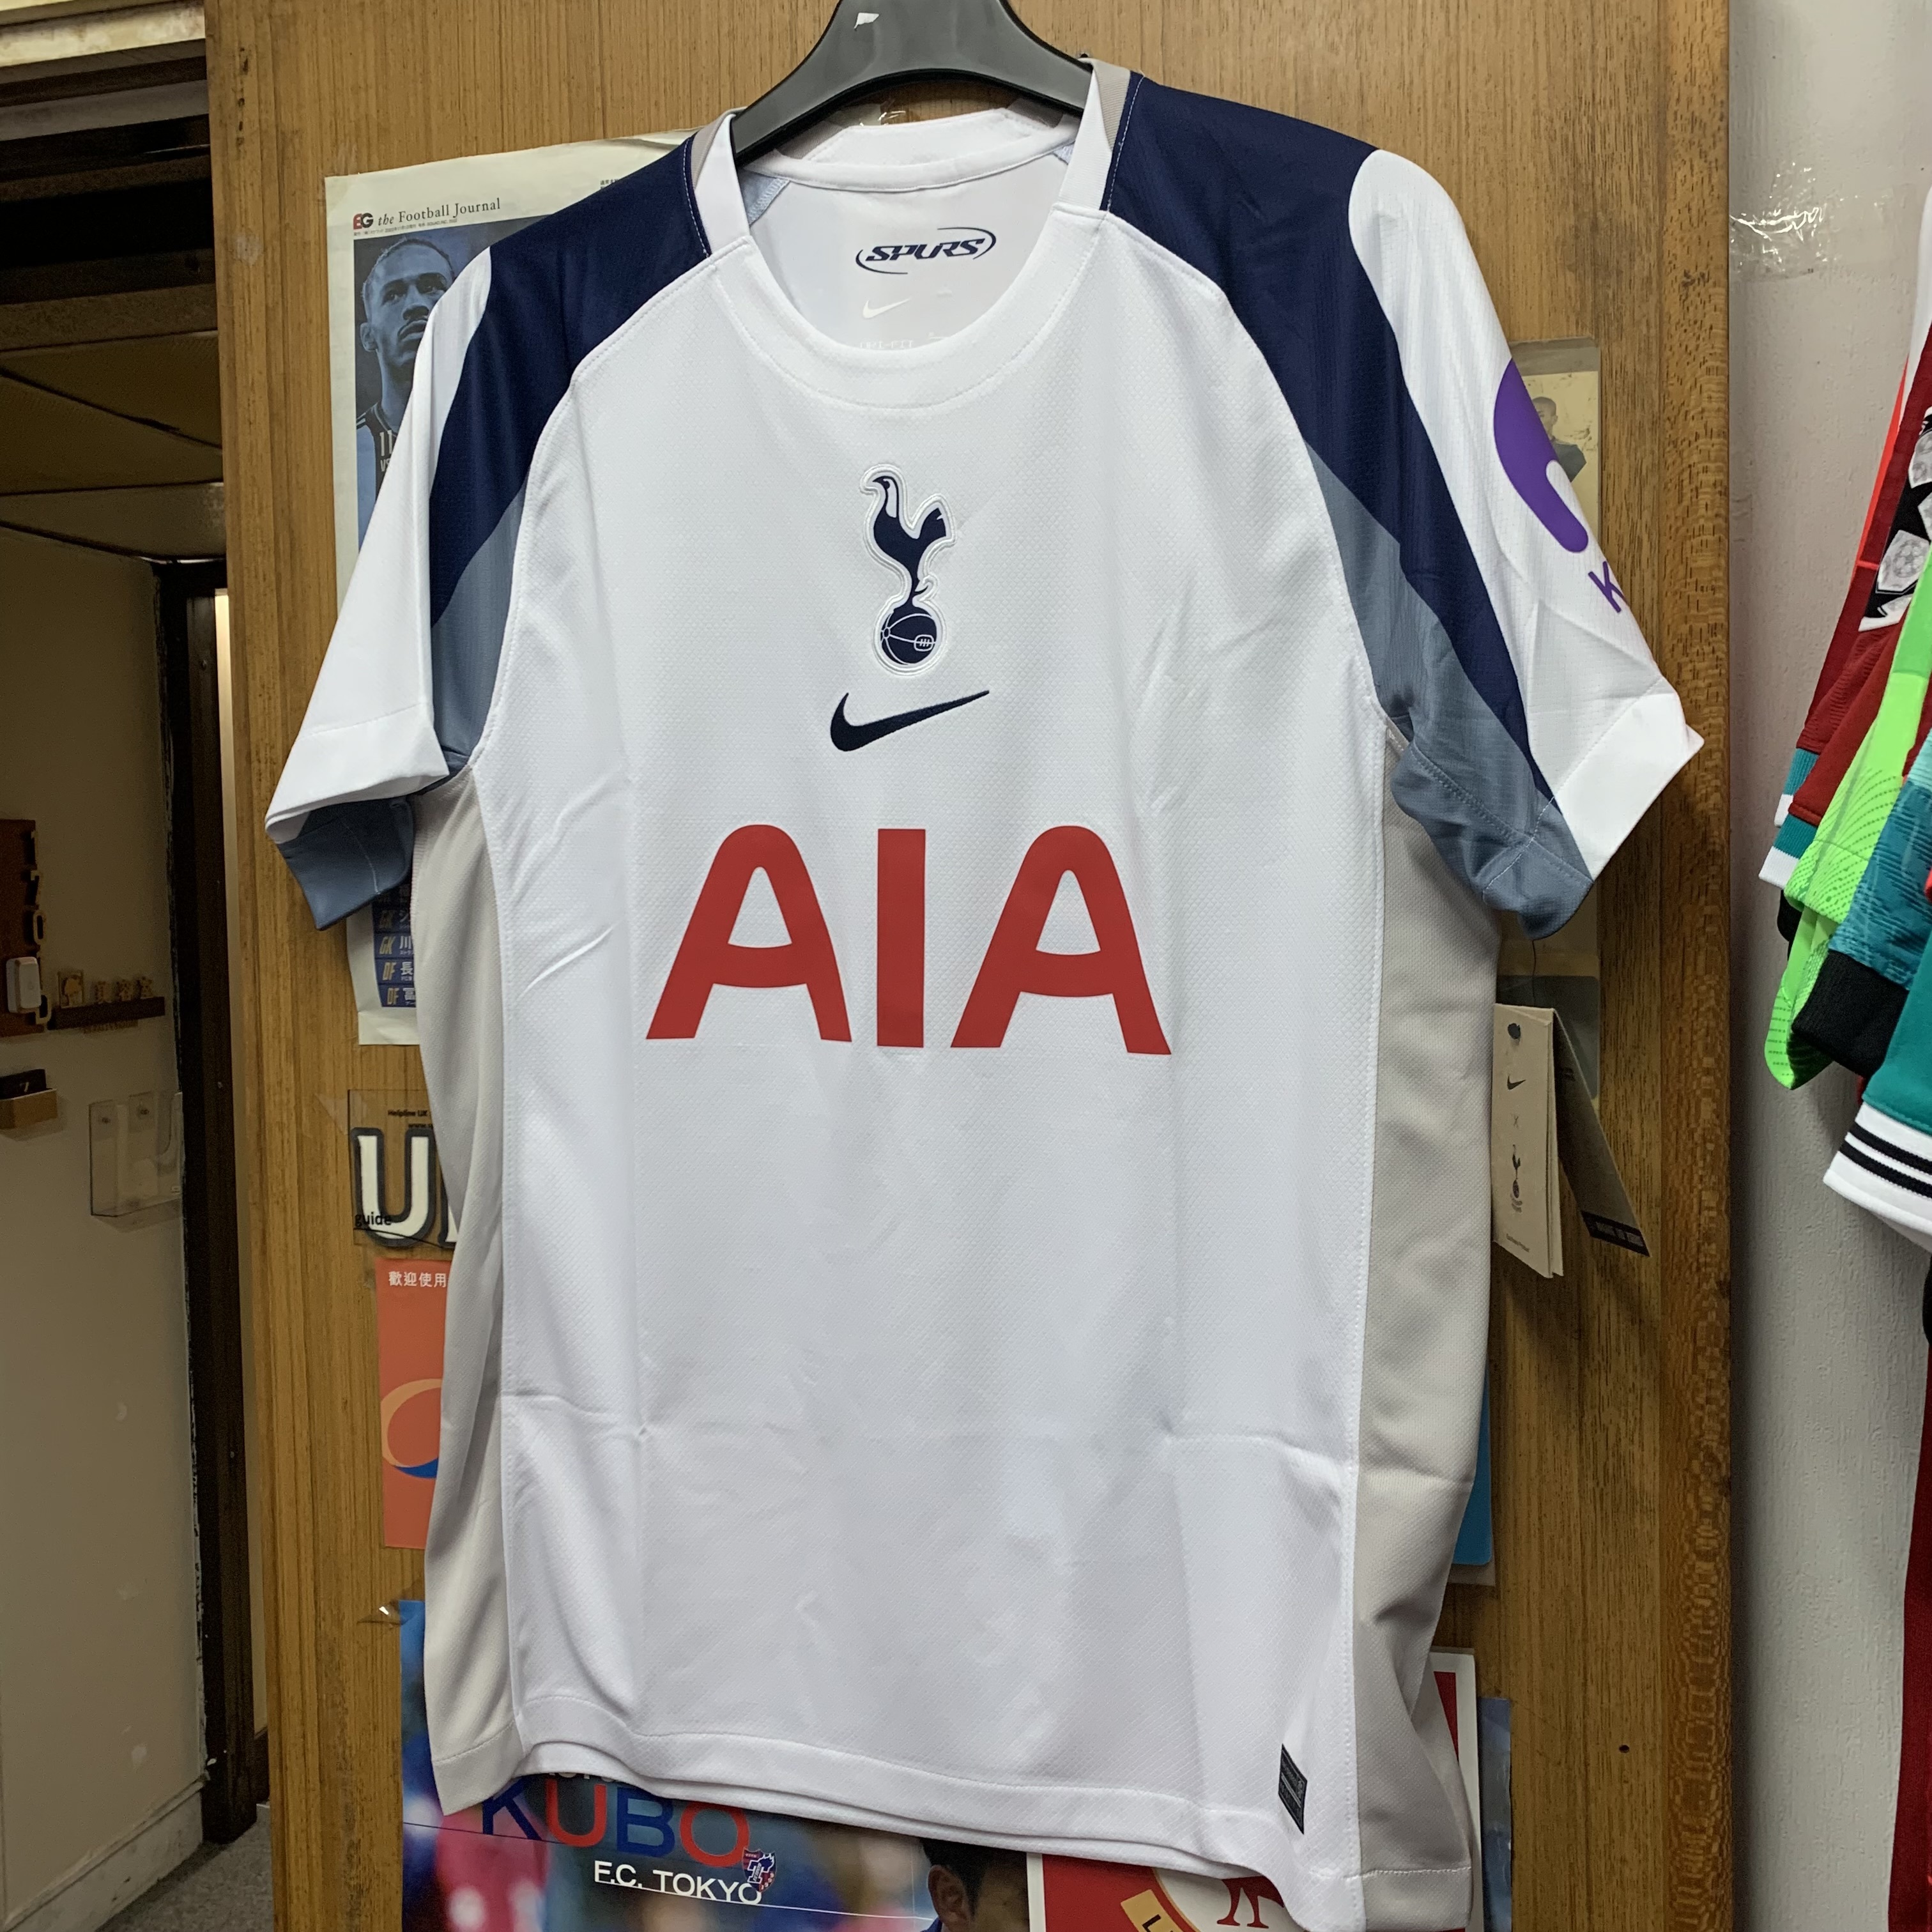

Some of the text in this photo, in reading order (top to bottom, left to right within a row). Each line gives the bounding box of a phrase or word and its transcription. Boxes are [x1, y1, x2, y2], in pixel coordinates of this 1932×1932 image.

[378, 213, 394, 226] the
[399, 204, 450, 222] Football
[453, 197, 501, 218] Journal
[865, 238, 985, 261] SPURS
[646, 824, 1172, 1055] AIA
[355, 1211, 392, 1228] guide
[388, 1271, 447, 1288] 歡迎使用
[482, 1777, 750, 1867] KUBO
[652, 1869, 763, 1905] TOKYO
